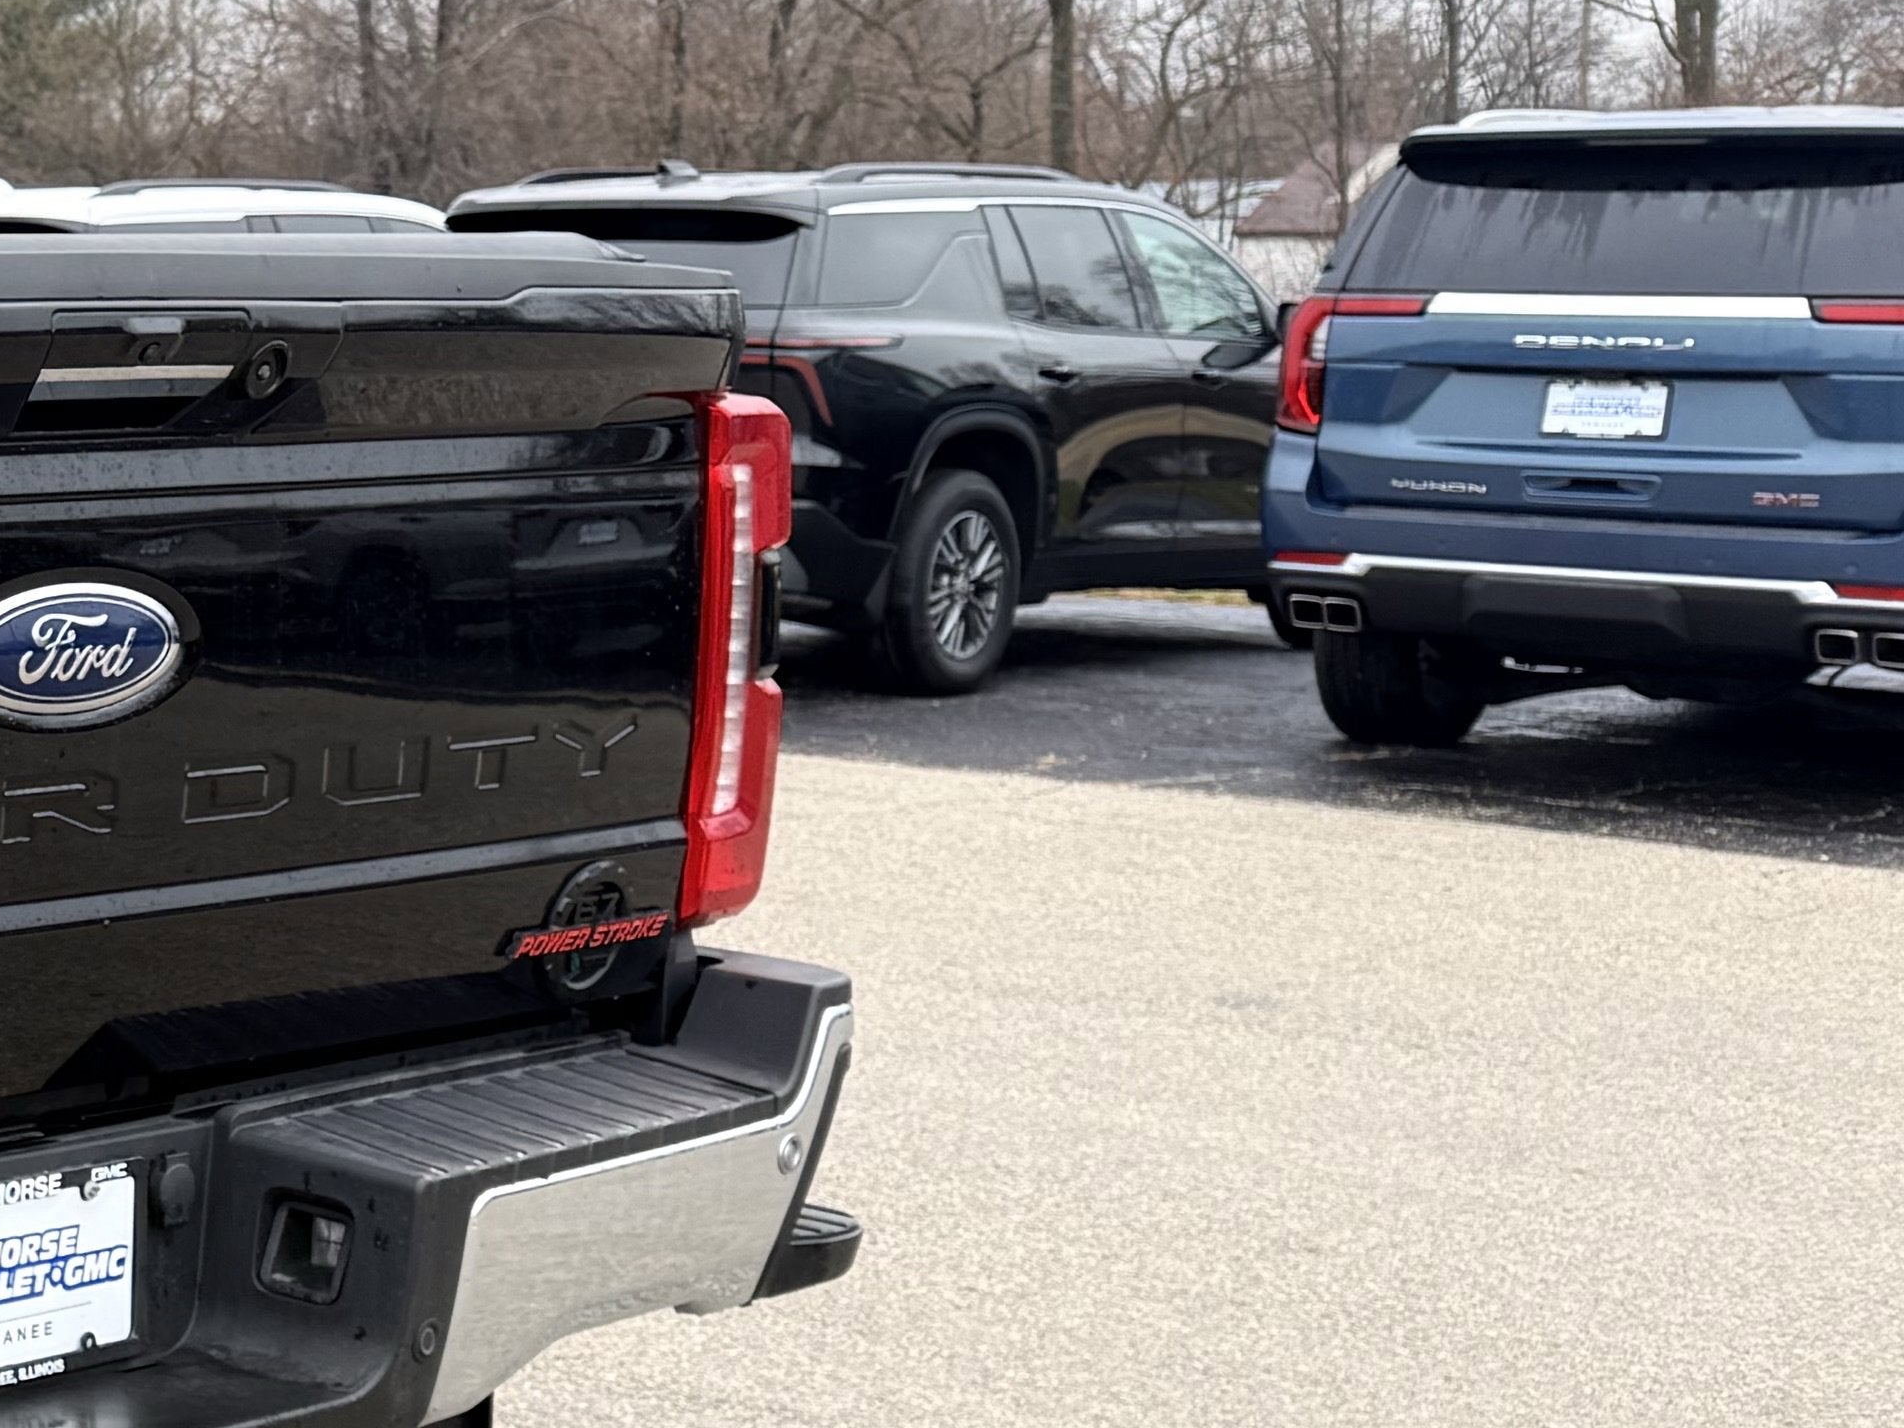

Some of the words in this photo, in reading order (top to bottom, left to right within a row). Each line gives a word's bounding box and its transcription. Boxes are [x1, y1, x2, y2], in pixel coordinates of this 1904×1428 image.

[1513, 334, 1695, 351] DENALI
[1753, 492, 1820, 507] GMC
[18, 612, 138, 685] Ford
[180, 715, 641, 826] DUTY
[512, 926, 592, 960] POWER
[589, 912, 671, 947] STROKE
[91, 1162, 128, 1181] GMC
[18, 1358, 66, 1381] ILLINOIS
